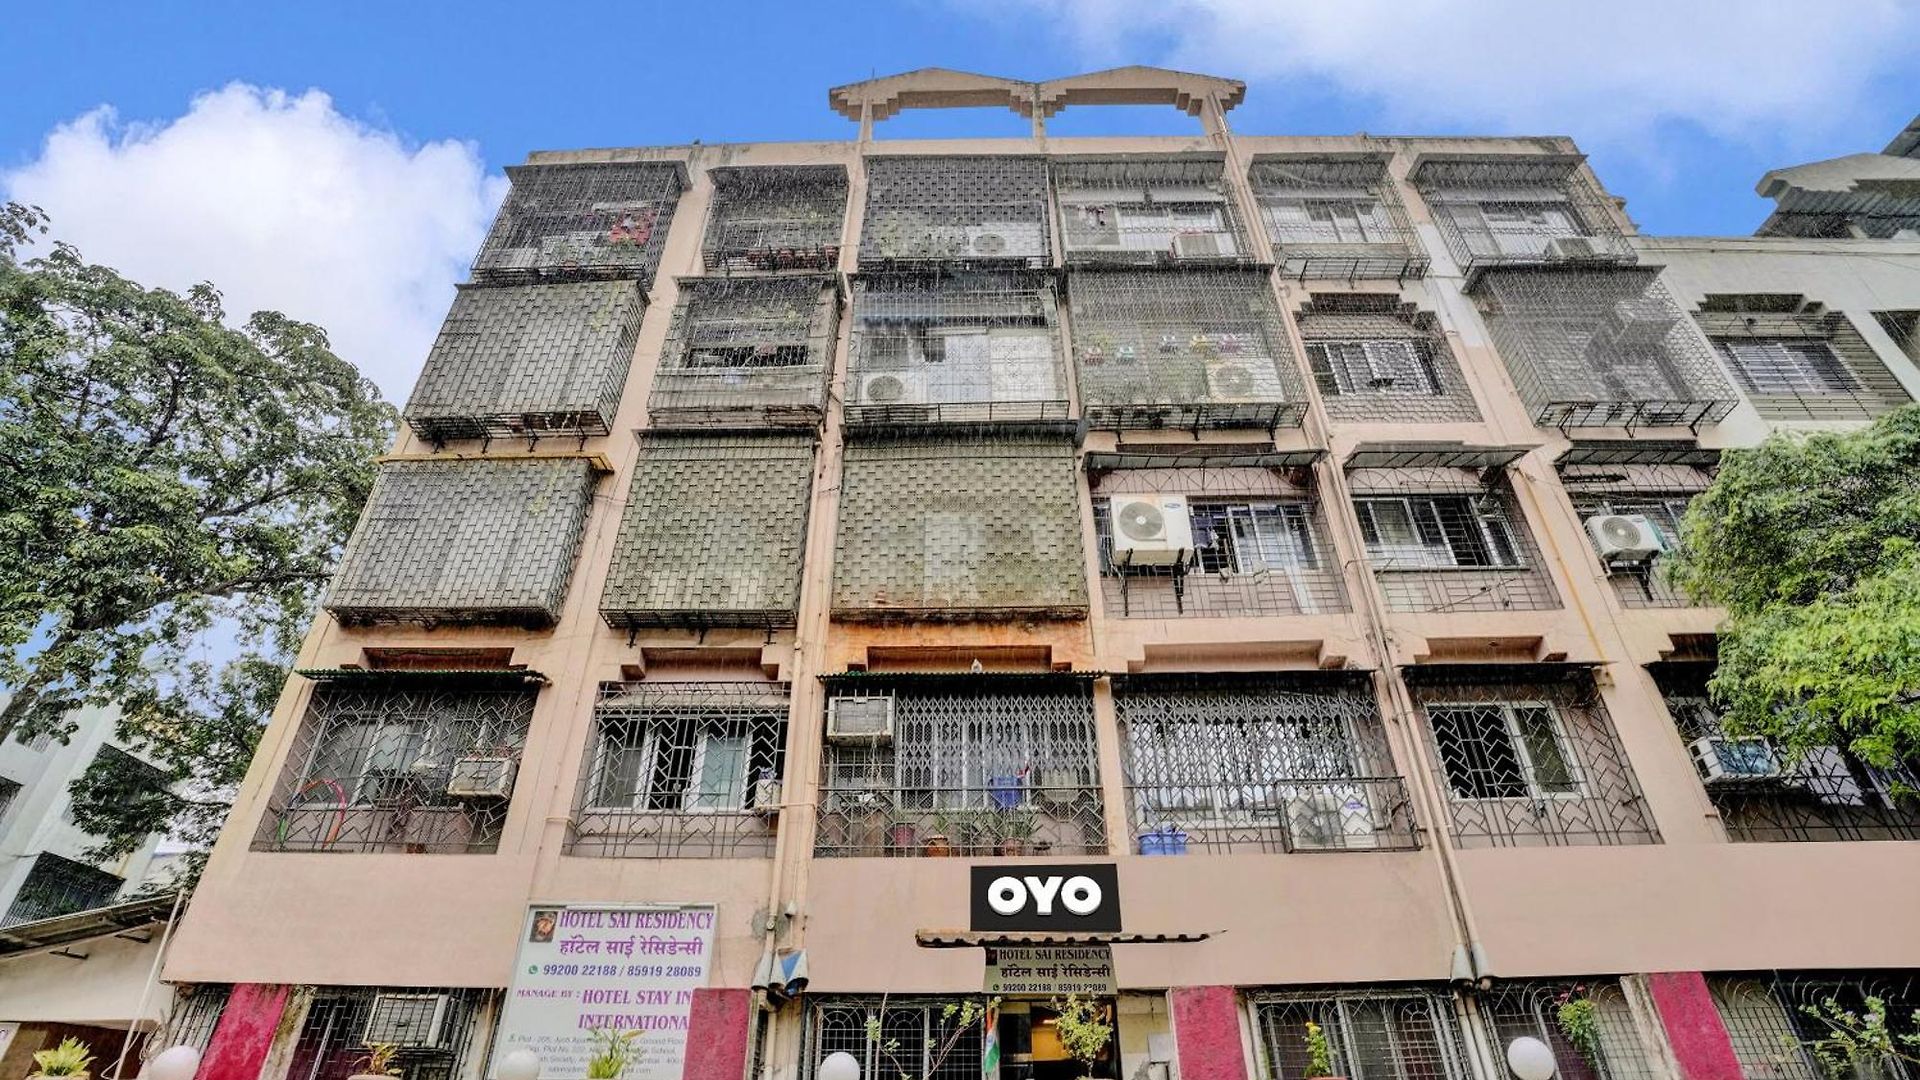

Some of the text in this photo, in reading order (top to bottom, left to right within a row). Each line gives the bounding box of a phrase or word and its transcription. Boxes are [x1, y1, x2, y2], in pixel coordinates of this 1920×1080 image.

[987, 875, 1102, 916] OYO
[559, 910, 714, 930] HOTEL SAI RESIDENCY
[559, 934, 599, 954] हॉटेल
[606, 935, 636, 959] साई
[1000, 949, 1111, 960] HOTEL SAI RESIDENCY
[543, 964, 578, 976] 99200
[581, 965, 617, 977] 22188
[627, 965, 663, 977] 85919
[516, 990, 557, 998] MANAGE
[582, 990, 631, 1005] HOTEL
[635, 990, 670, 1005] STAY
[578, 1014, 689, 1030] INTERNATIONA
